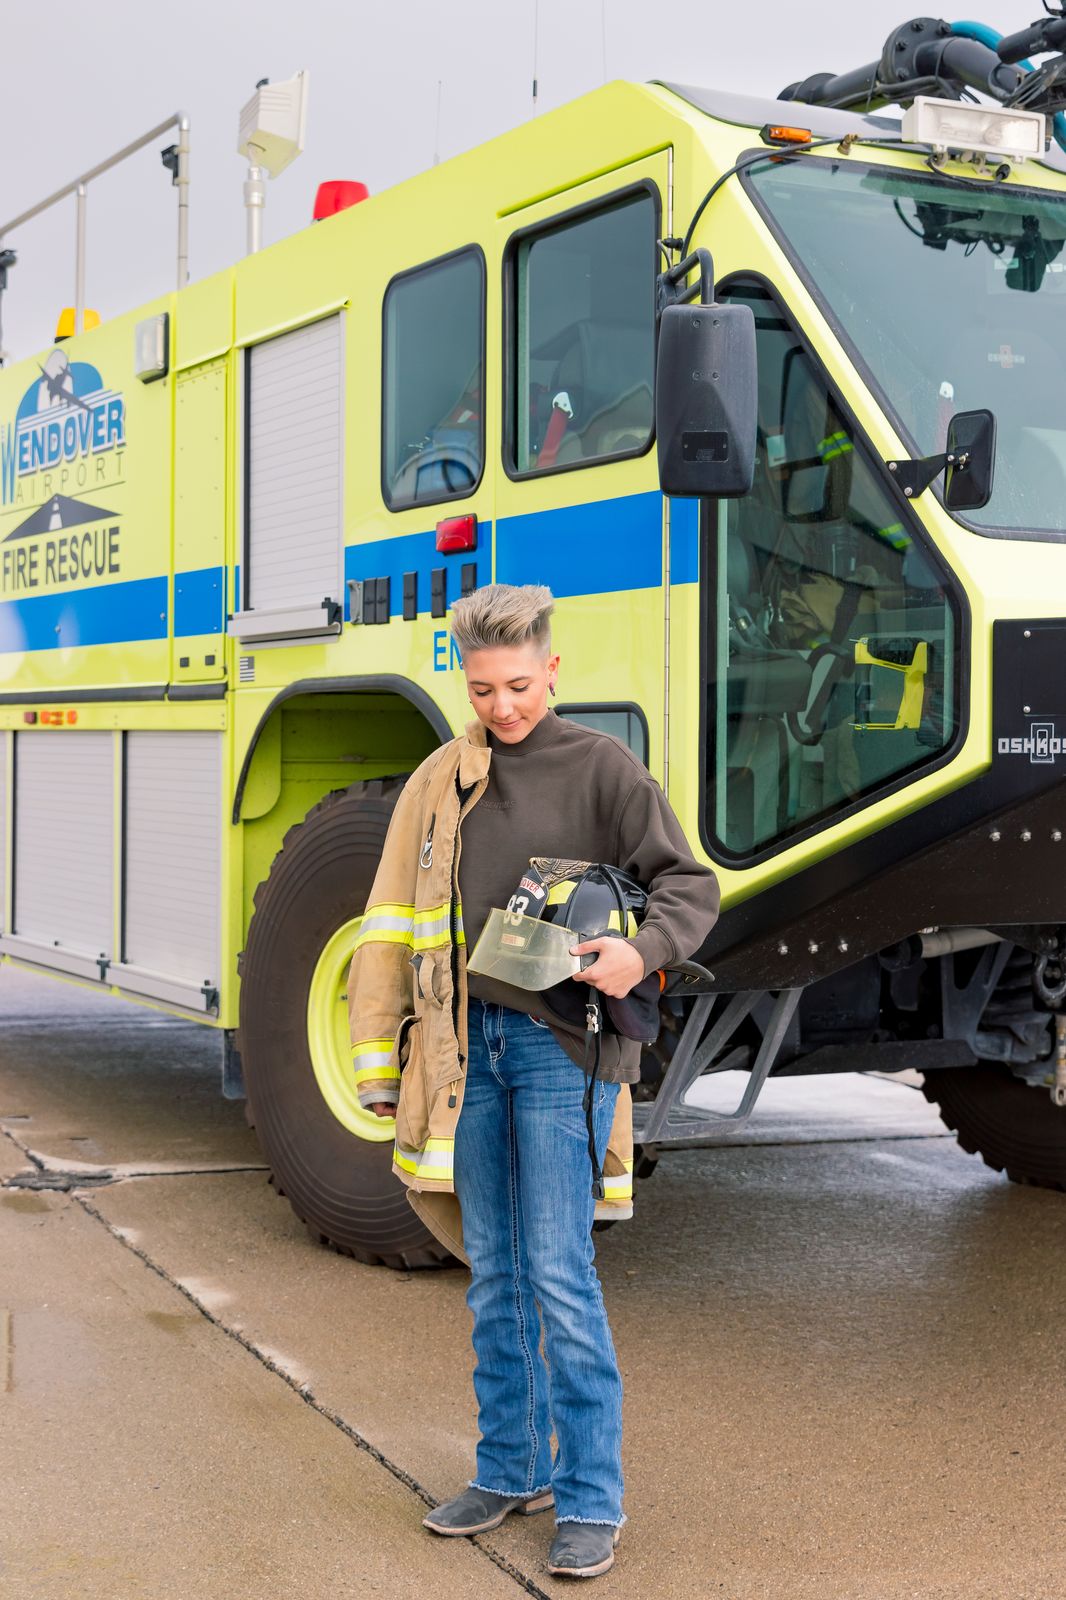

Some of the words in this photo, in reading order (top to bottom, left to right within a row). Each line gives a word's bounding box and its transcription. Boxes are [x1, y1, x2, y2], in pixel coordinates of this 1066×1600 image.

[1, 398, 126, 506] WENDOVER
[16, 451, 124, 504] AIRPORT
[3, 544, 38, 592] FIRE
[46, 526, 120, 584] RESCUE
